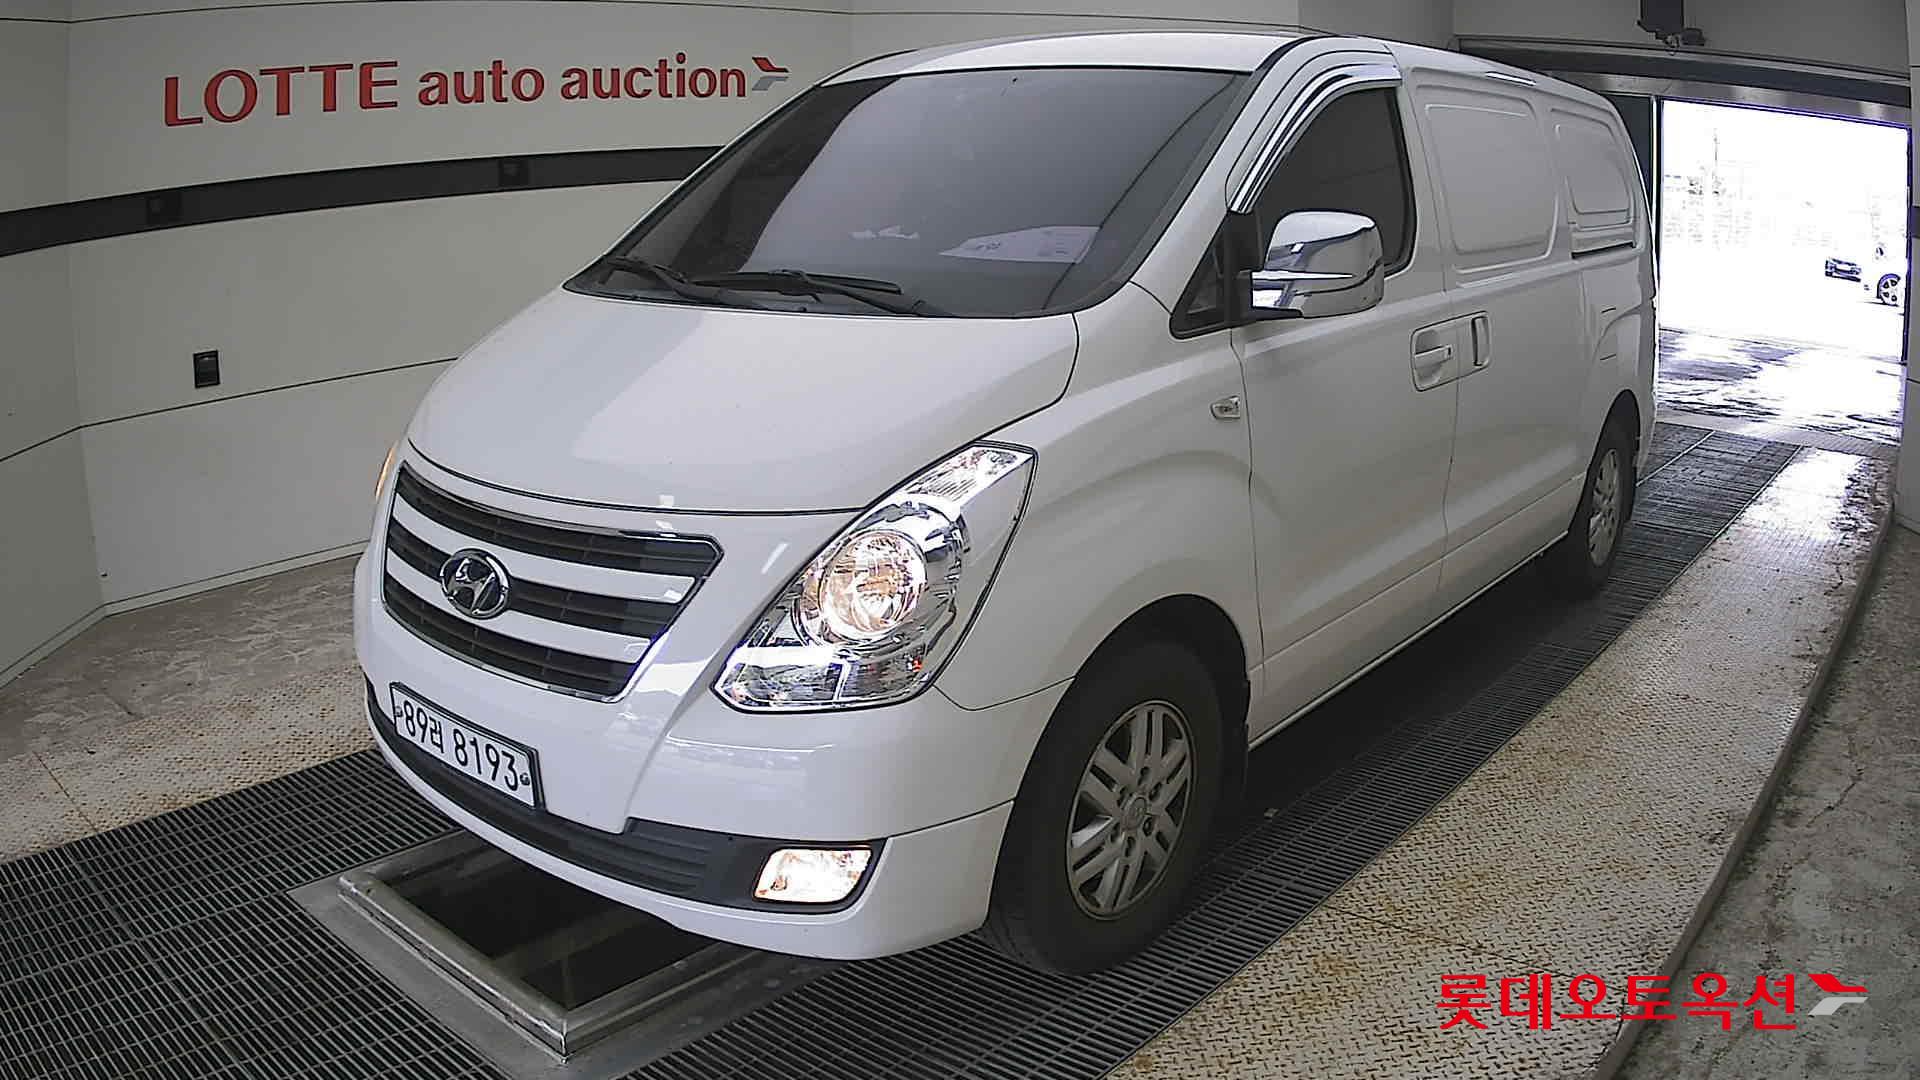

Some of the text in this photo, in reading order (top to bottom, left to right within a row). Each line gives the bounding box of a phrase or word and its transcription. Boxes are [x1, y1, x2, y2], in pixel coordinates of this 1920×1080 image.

[164, 52, 747, 127] LOTTE auto auction
[453, 728, 519, 791] 8193
